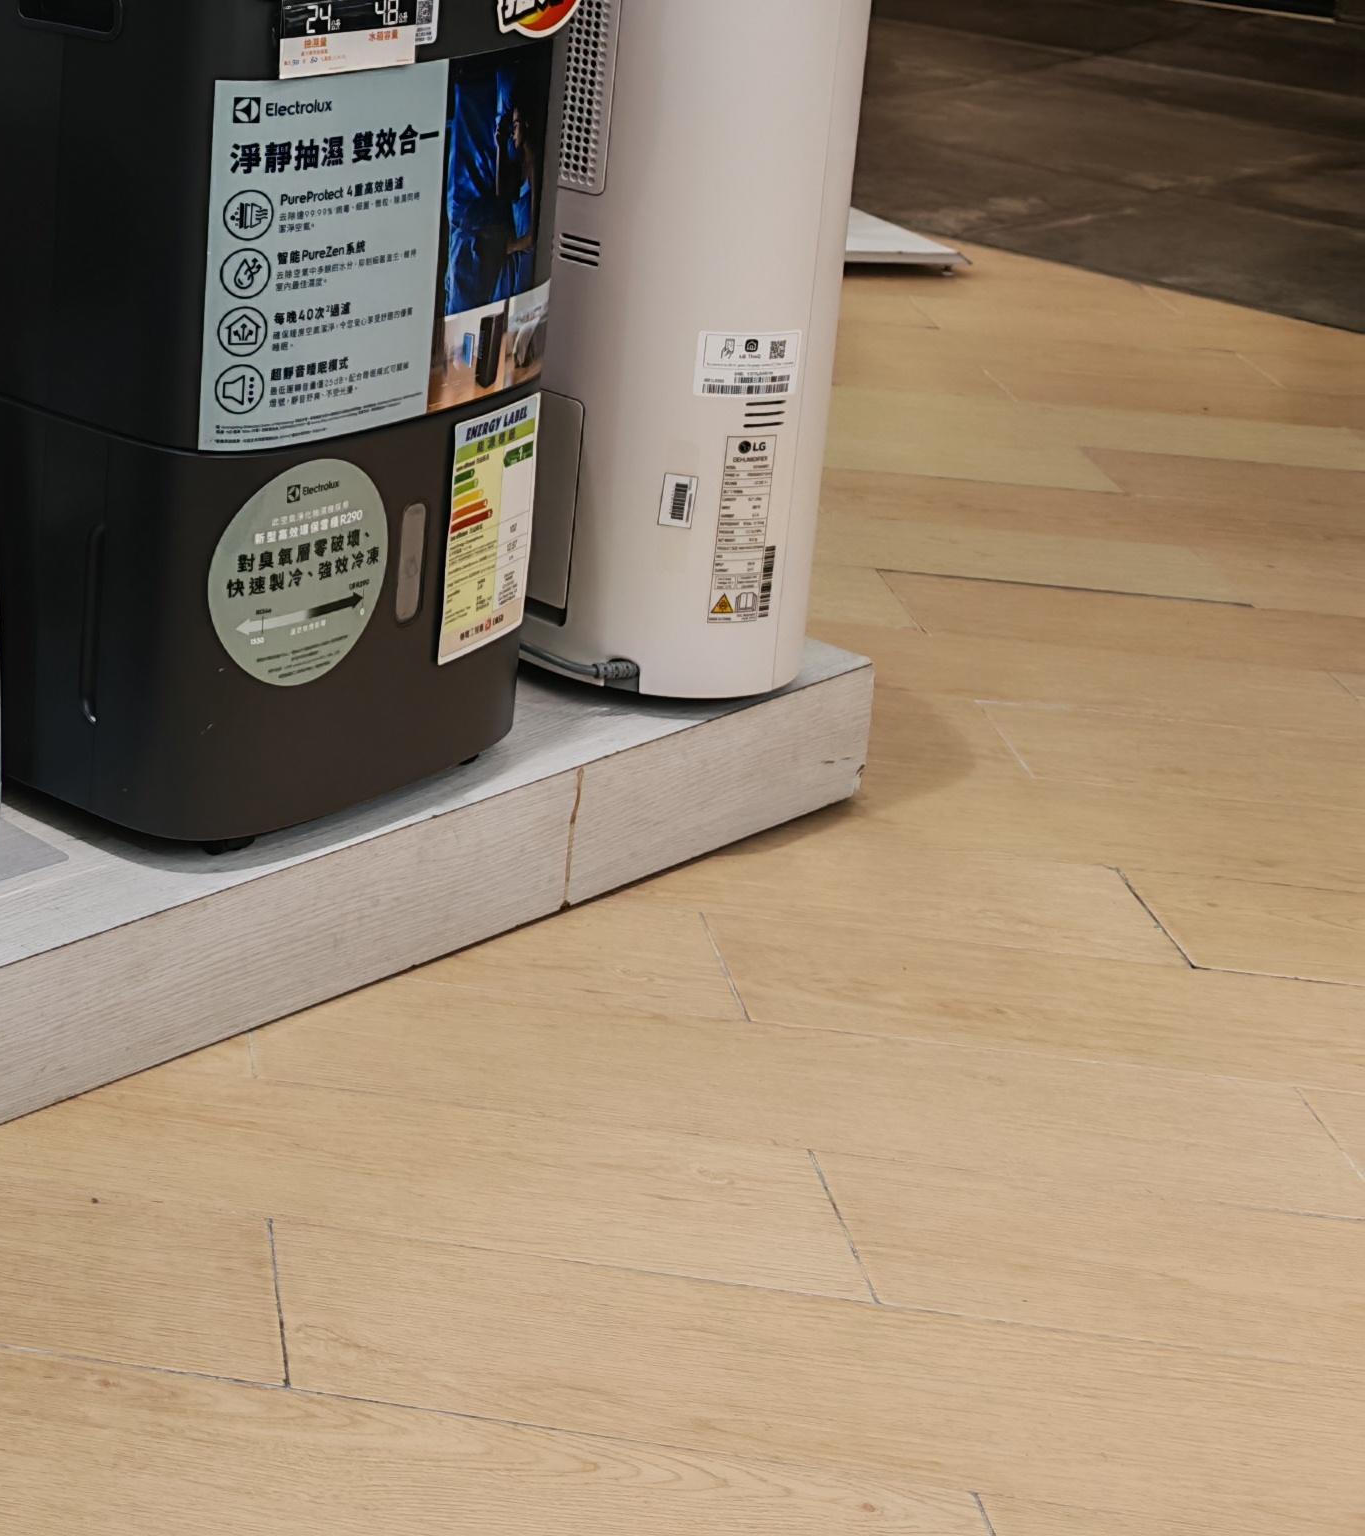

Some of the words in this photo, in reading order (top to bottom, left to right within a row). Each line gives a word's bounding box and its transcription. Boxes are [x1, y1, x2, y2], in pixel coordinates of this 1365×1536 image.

[306, 4, 331, 33] 24
[368, 30, 398, 42] 水箱容量
[266, 100, 332, 117] Electrolux
[229, 135, 344, 174] 淨靜抽濕
[352, 124, 440, 164] 雙效合一
[280, 187, 344, 205] PureProtect
[346, 176, 404, 198] 4重高效過濾
[277, 240, 366, 264] 智能PureZen系統
[270, 356, 349, 382] 超靜音睡眠模式
[465, 416, 502, 442] ENERGY
[503, 405, 527, 428] LABEL
[752, 441, 767, 452] LG
[302, 480, 340, 496] Electrolux
[226, 546, 380, 599] 快速製冷、強效冷凍
